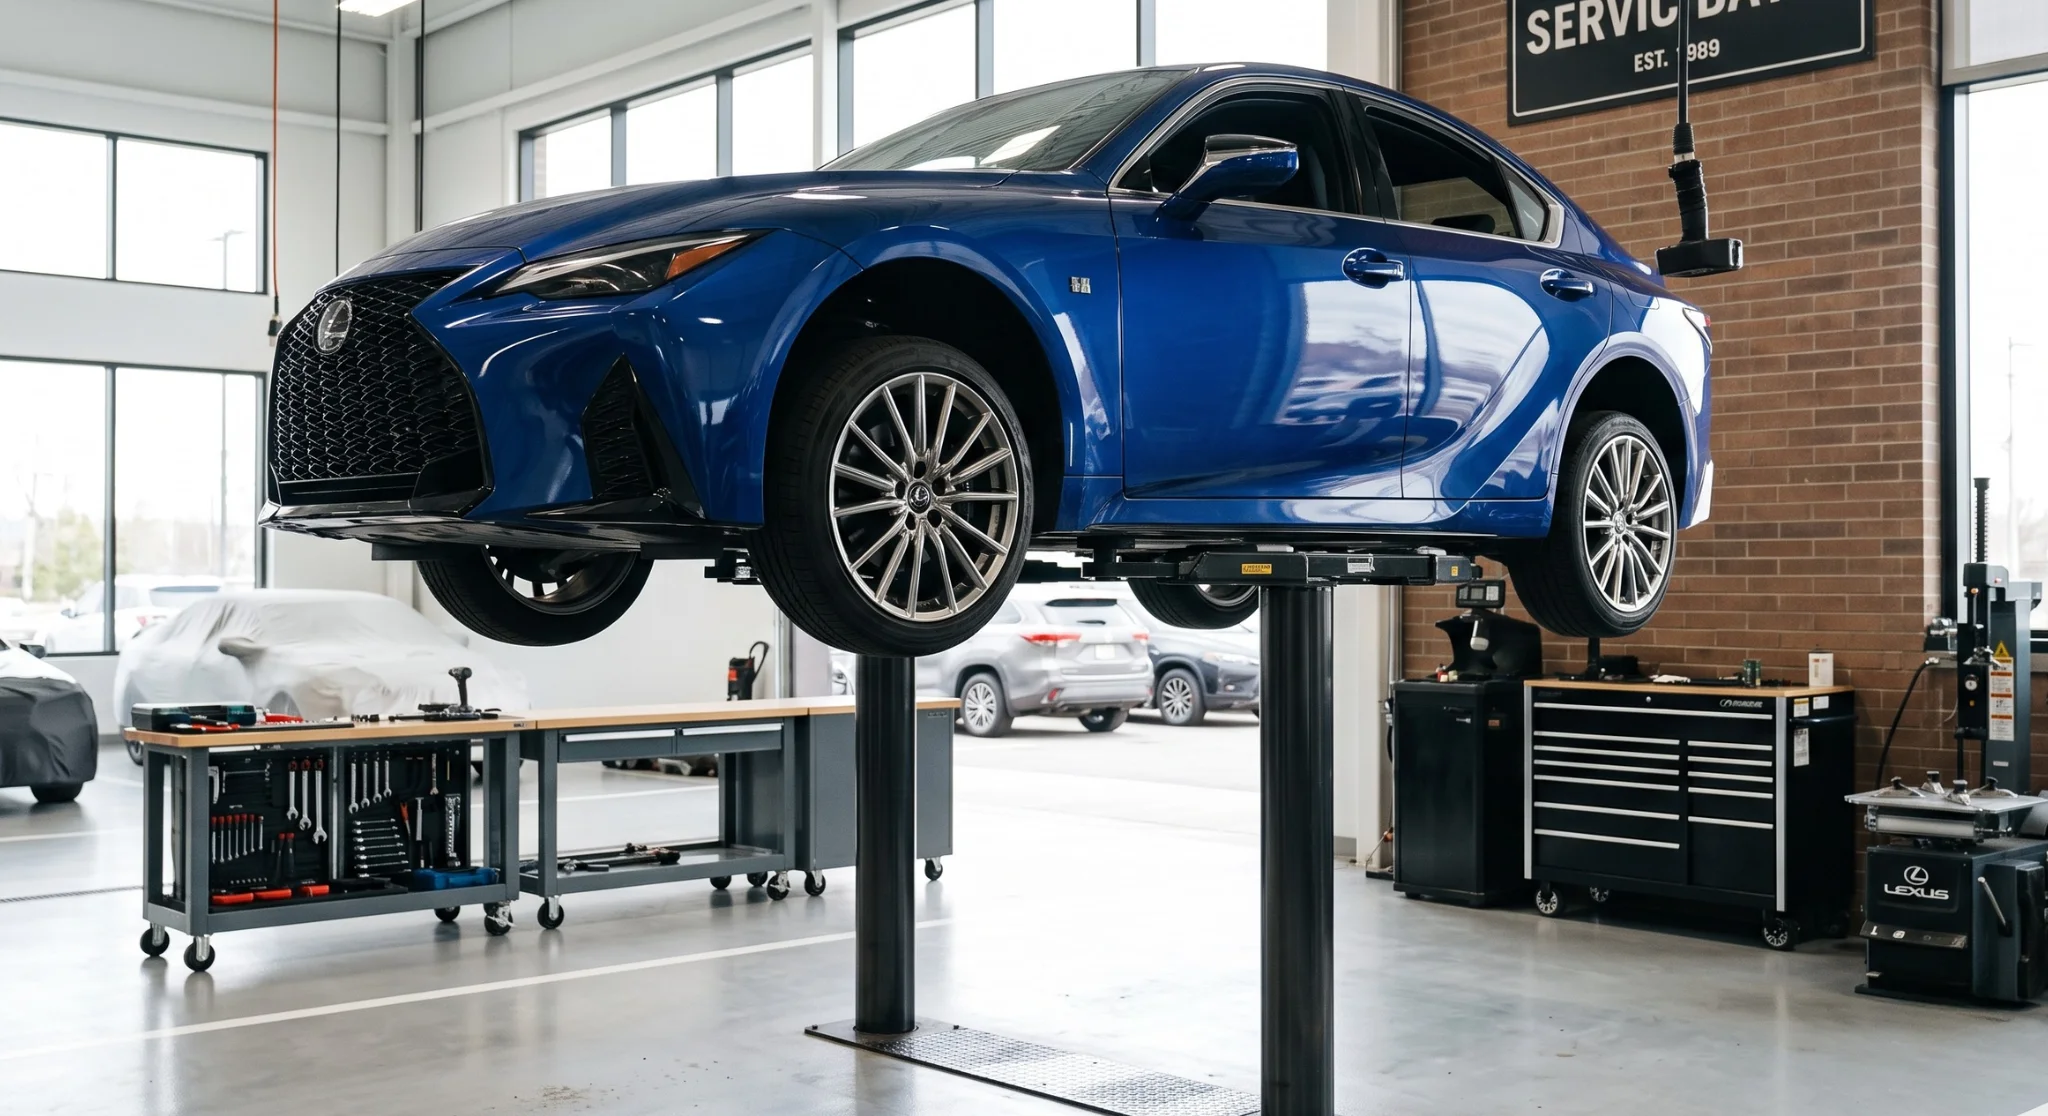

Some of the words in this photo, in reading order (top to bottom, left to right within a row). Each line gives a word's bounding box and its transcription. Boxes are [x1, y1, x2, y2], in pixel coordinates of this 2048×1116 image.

[1633, 49, 1669, 73] EST.
[1676, 38, 1720, 62] 989
[1883, 884, 1950, 900] LEXUS
